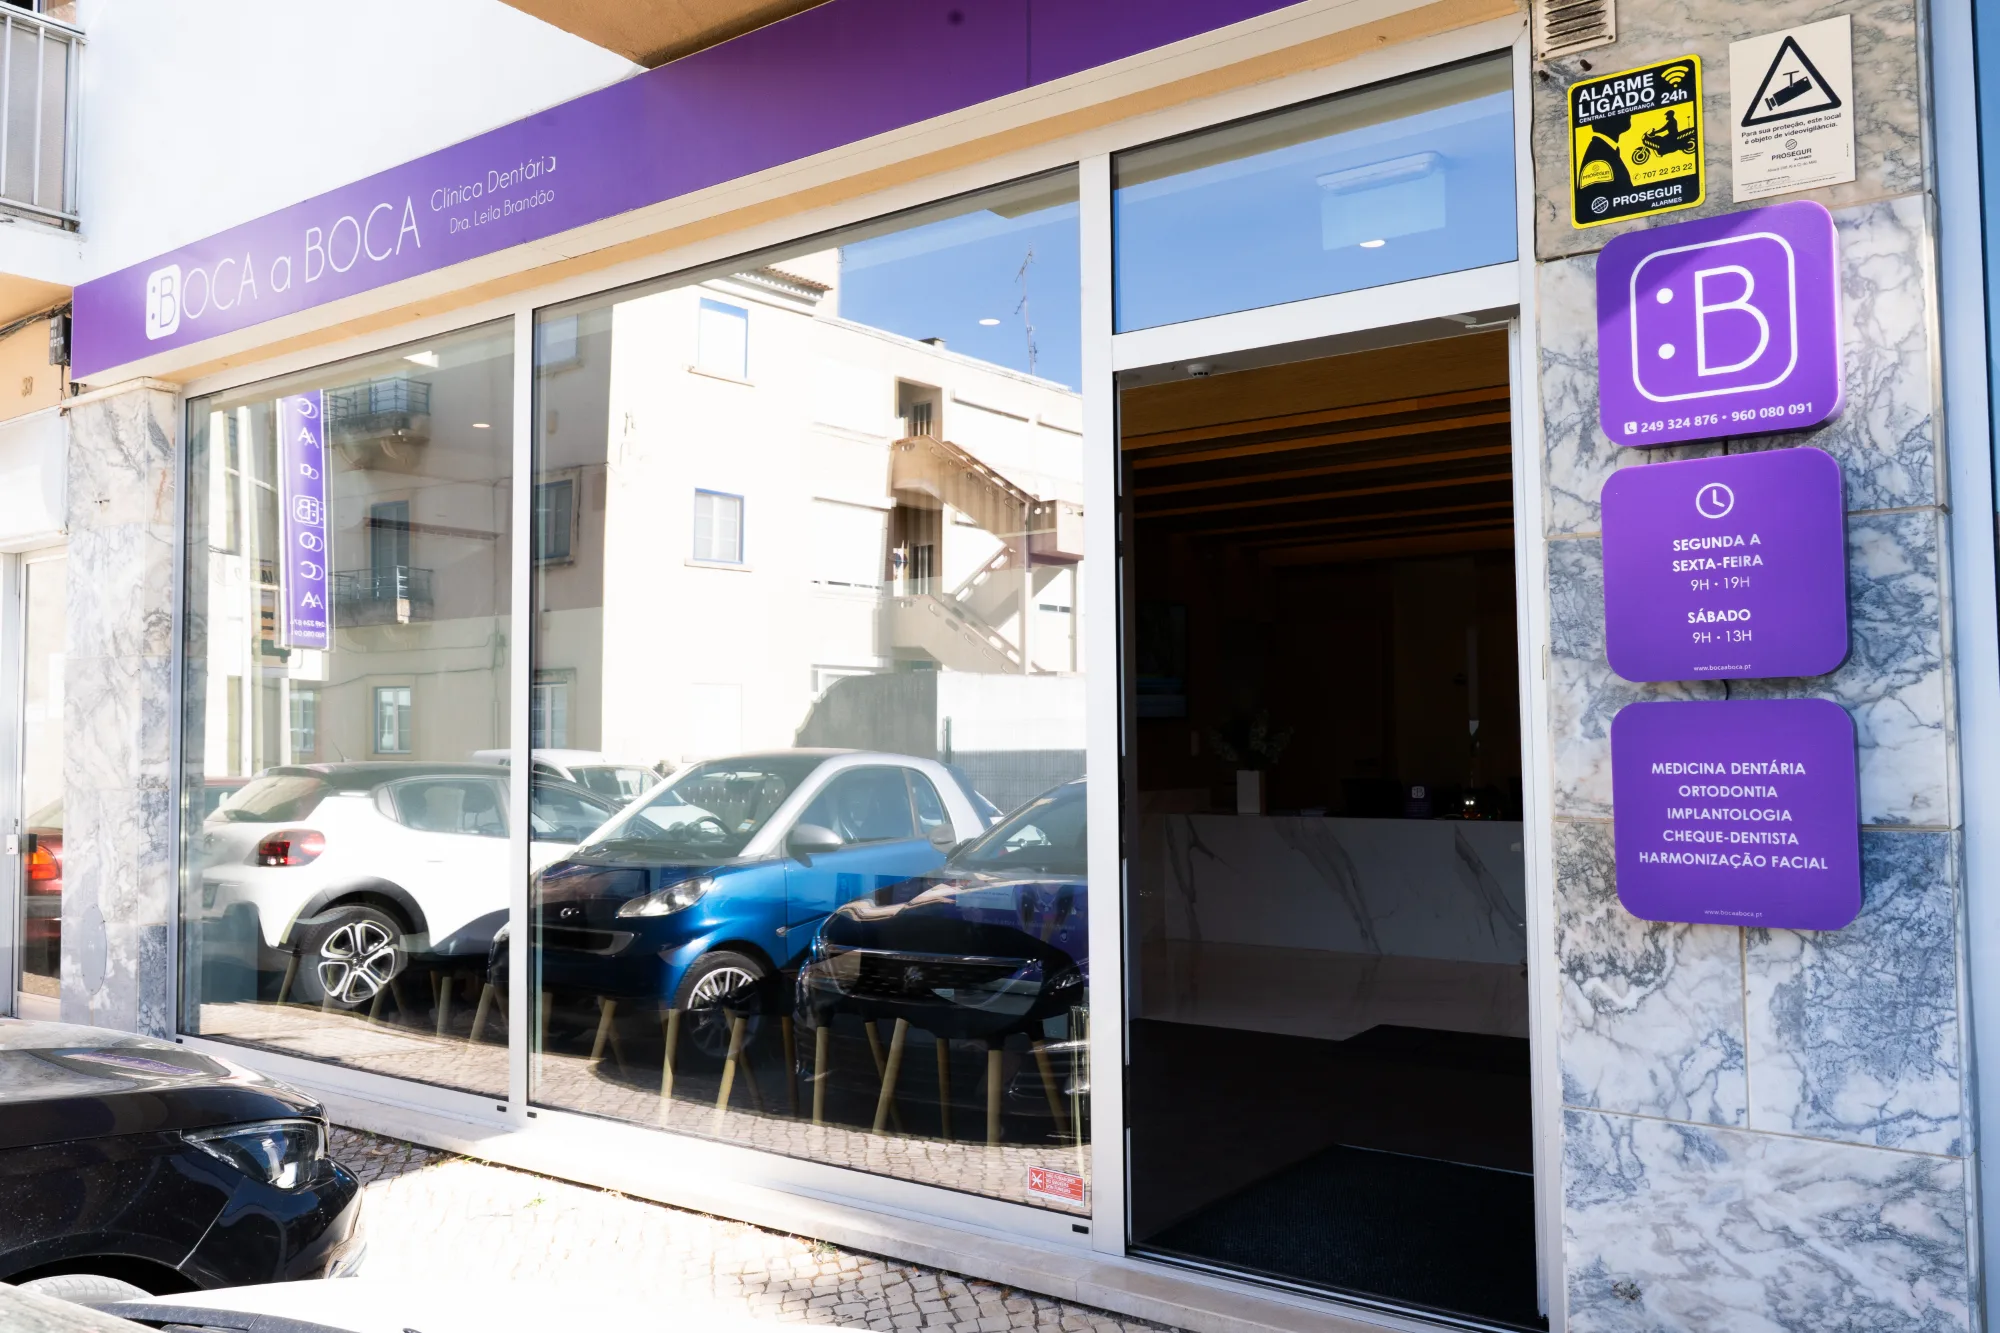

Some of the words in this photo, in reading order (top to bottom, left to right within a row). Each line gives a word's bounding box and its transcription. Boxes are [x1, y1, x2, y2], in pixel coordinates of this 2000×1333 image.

[1579, 73, 1654, 103] ALARME
[1578, 87, 1655, 118] LIGADO
[1660, 88, 1688, 105] 24h
[1579, 111, 1607, 124] CENTRAL
[1608, 109, 1616, 117] DE
[1617, 102, 1655, 115] SEGURANÇA
[1772, 120, 1806, 133] proteção,
[1807, 117, 1823, 125] este
[1824, 112, 1842, 121] local
[1750, 135, 1773, 144] objeto
[1784, 122, 1838, 137] videovigilância.
[1771, 148, 1812, 160] PROSEGUR
[1643, 170, 1657, 179] 707
[1659, 167, 1669, 176] 22
[1671, 165, 1681, 174] 23
[1682, 162, 1693, 171] 22
[430, 182, 482, 213] Clínica
[1612, 184, 1682, 207] PROSEGUR
[1651, 197, 1683, 208] ALARMES
[450, 217, 471, 234] Dra.
[474, 205, 501, 226] Leila
[504, 190, 555, 216] Brandão
[270, 255, 291, 293] a
[305, 195, 421, 283] BOCA
[1641, 420, 1664, 433] 249
[1667, 417, 1691, 430] 324
[1694, 413, 1718, 427] 876
[1731, 408, 1756, 422] 960
[1759, 405, 1784, 419] 080
[1788, 402, 1813, 415] 091
[1672, 534, 1746, 552] SEGUNDA
[1750, 533, 1762, 545] A
[1672, 554, 1764, 572] SEXTA-FEIRA
[1690, 578, 1710, 591] 9H
[1723, 576, 1750, 589] 19H
[1687, 607, 1751, 624] SÁBADO
[1692, 631, 1711, 644] 9H
[1725, 630, 1752, 642] 13H
[1693, 663, 1752, 671] www.bocaaboca.pt
[1651, 762, 1727, 775] MEDICINA
[1731, 759, 1806, 775] DENTÁRIA
[1678, 784, 1778, 798] ORTODONTIA
[1667, 807, 1793, 822] IMPLANTOLOGIA
[1663, 829, 1799, 845] CHEQUE-DENTISTA
[1639, 851, 1767, 869] HARMONIZAÇÃO
[1771, 855, 1828, 870] FACIAL
[1704, 909, 1763, 918] www.bocaaboca.pt
